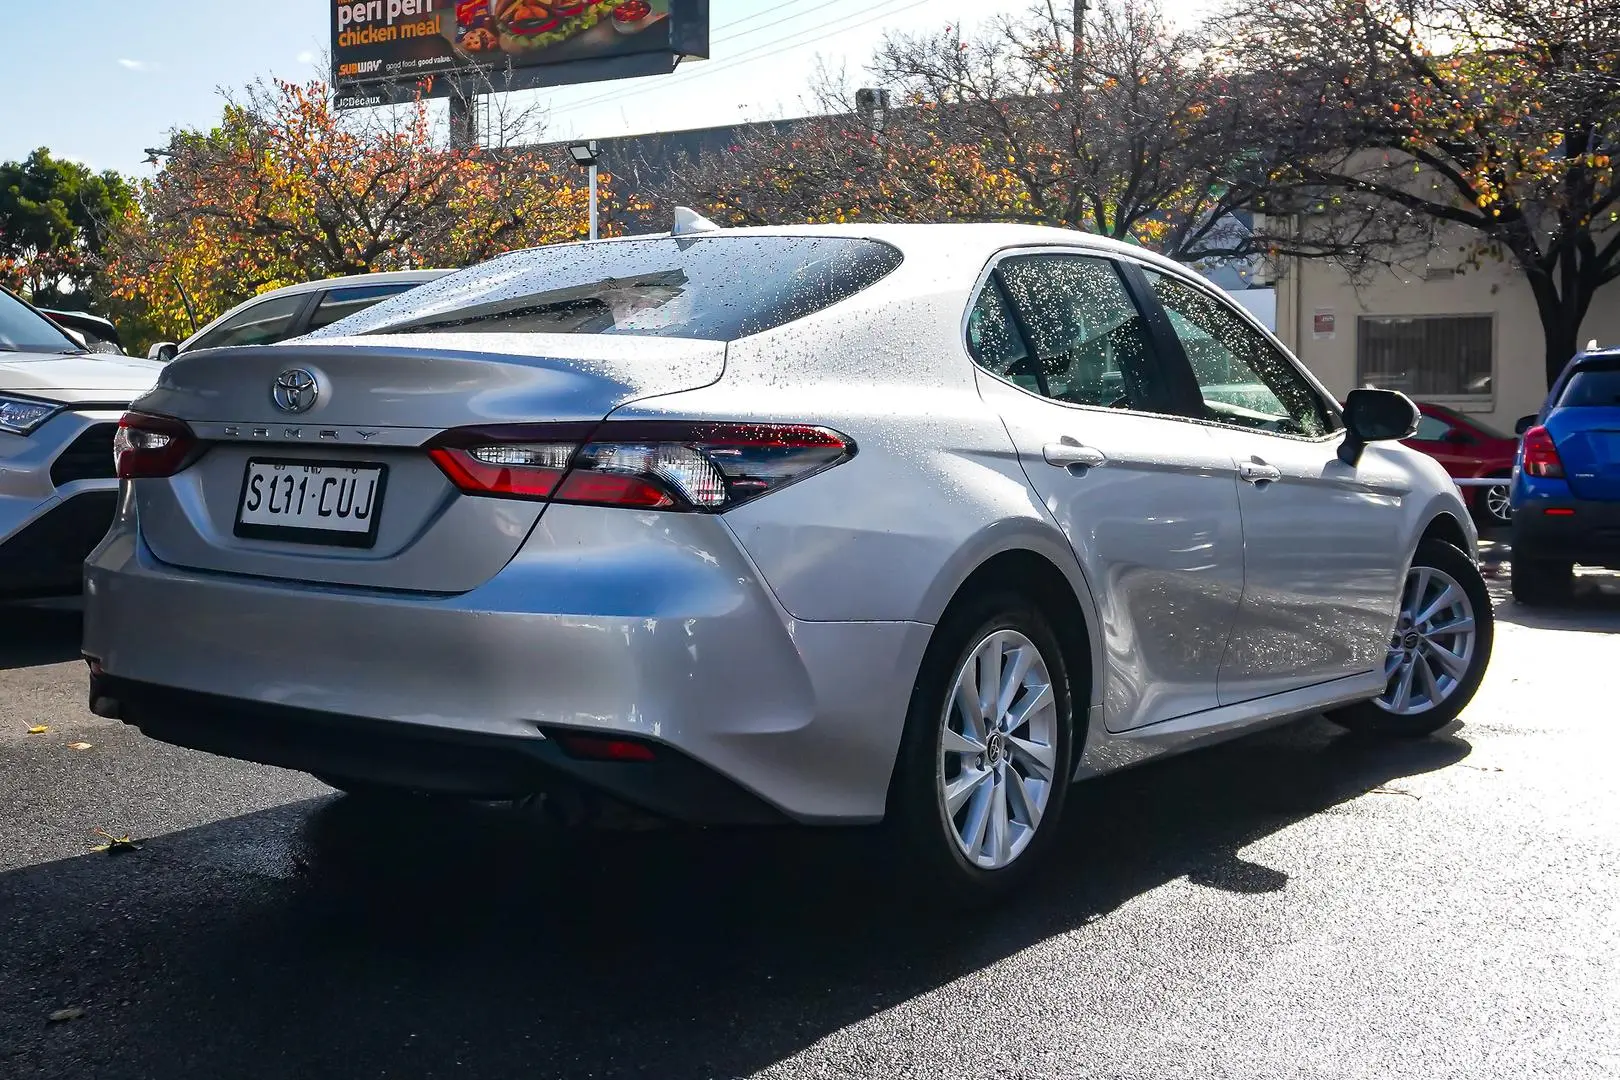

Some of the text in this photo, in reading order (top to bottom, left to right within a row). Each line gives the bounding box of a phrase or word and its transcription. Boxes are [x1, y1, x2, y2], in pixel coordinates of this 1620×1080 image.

[338, 0, 382, 32] peri
[339, 15, 441, 47] chicken meal
[338, 60, 382, 76] SUBWAY
[386, 62, 401, 71] good
[417, 57, 433, 67] good
[337, 96, 381, 108] JCDecaux
[225, 426, 380, 441] CAMRY
